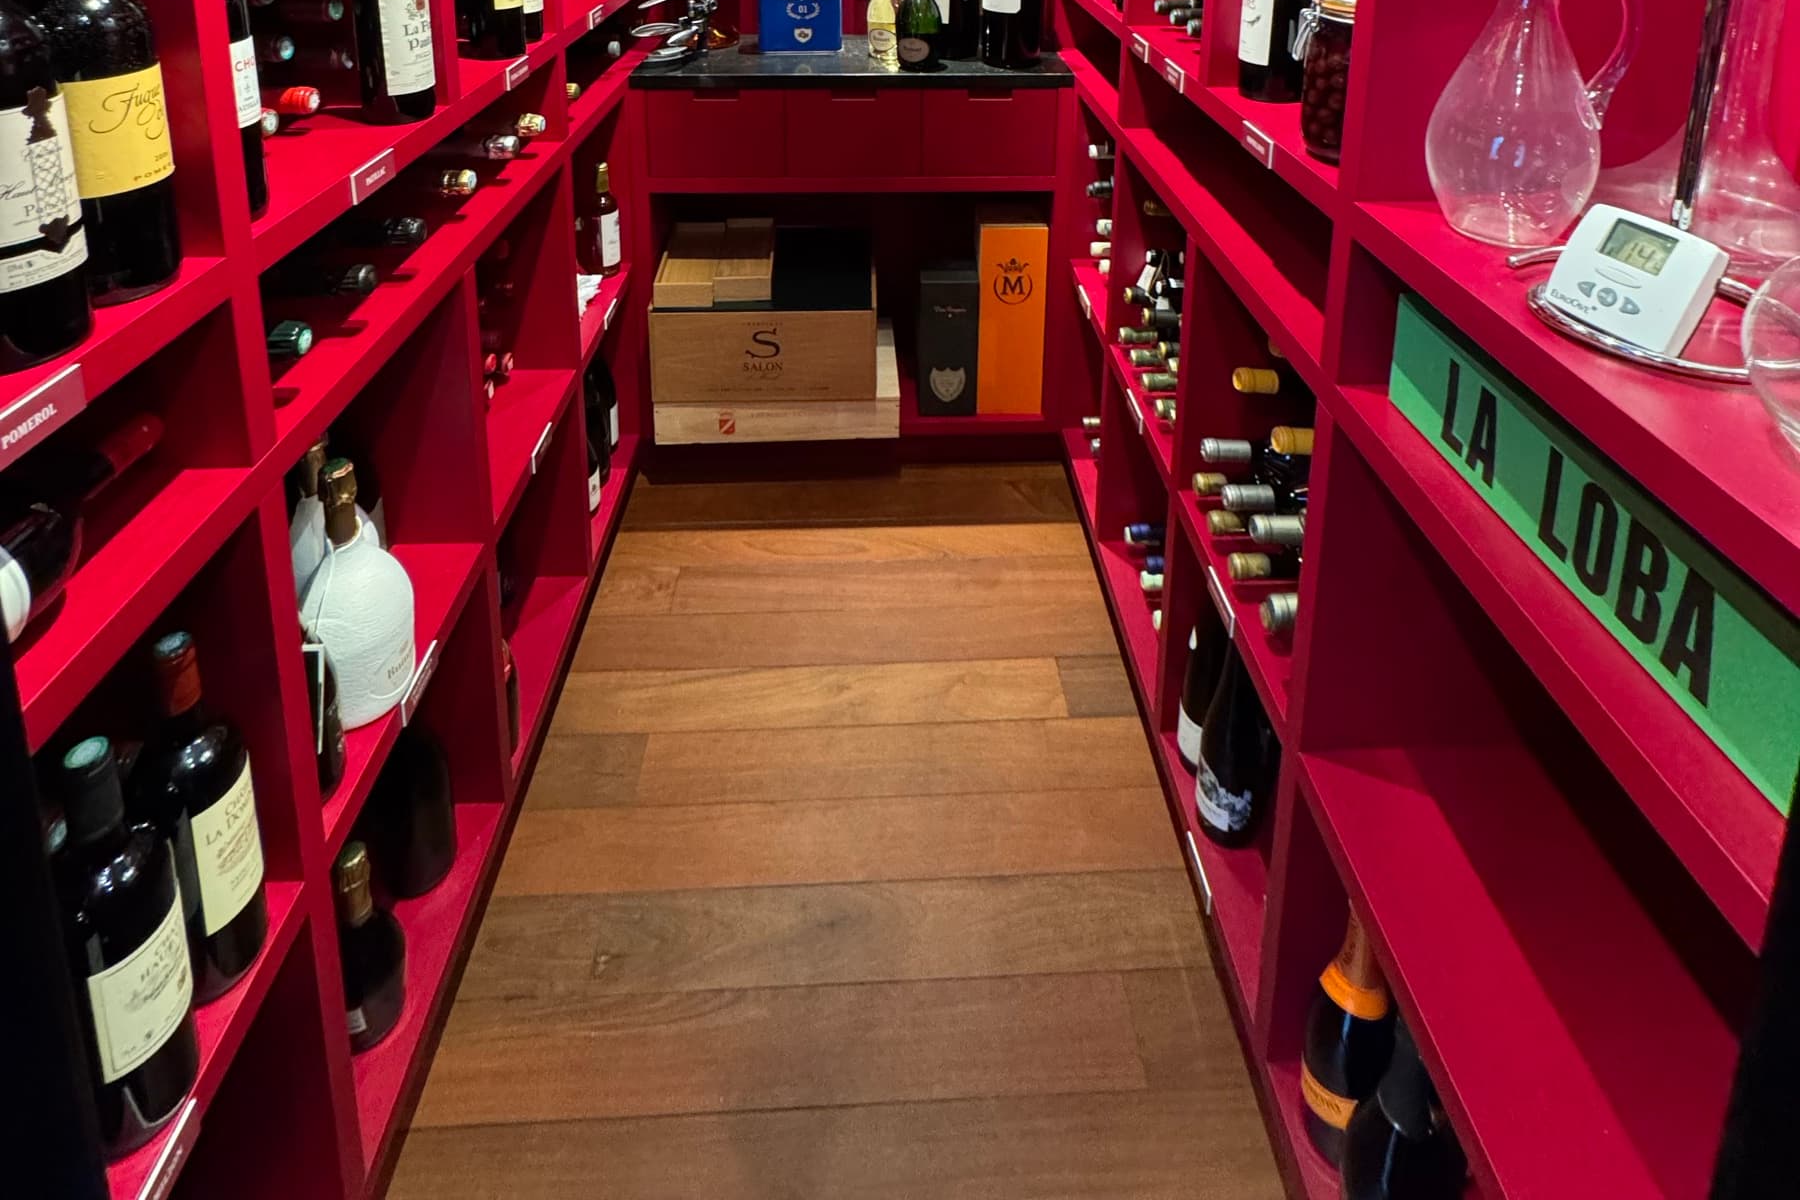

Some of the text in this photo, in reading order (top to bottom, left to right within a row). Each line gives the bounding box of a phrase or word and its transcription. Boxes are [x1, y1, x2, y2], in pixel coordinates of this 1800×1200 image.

[745, 327, 780, 359] S
[743, 361, 783, 372] SALON
[1, 403, 58, 450] POMEROL
[1440, 358, 1716, 709] LA LOBA
